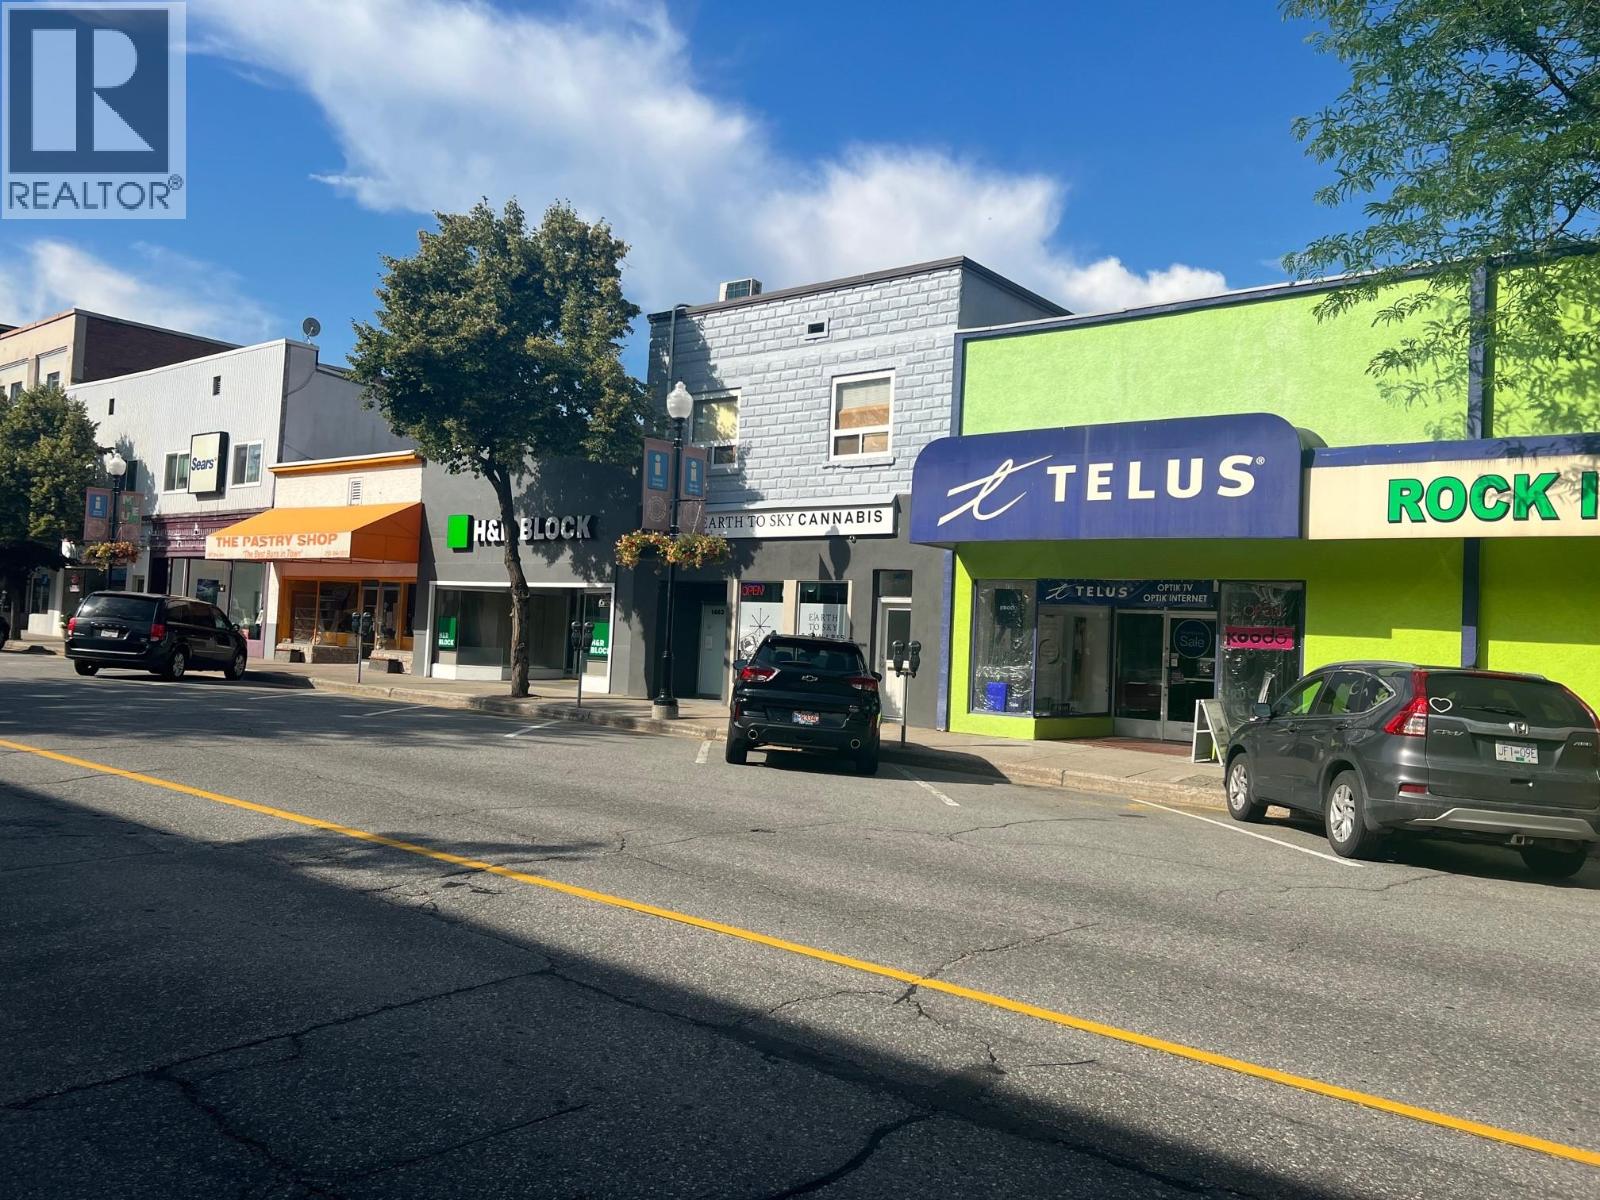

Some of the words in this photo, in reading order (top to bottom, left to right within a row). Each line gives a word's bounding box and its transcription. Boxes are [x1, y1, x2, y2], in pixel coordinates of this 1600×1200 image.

[191, 457, 215, 471] Sears
[1387, 472, 1561, 524] ROCK
[748, 513, 766, 528] TO
[770, 514, 795, 527] SKY
[799, 510, 883, 526] CANNABIS
[520, 514, 592, 541] BLOCK
[216, 537, 239, 548] THE
[242, 534, 292, 548] PASTRY
[297, 533, 338, 547] SHOP
[1076, 586, 1128, 598] TELUS
[1157, 584, 1180, 592] OPTIK
[1143, 594, 1168, 602] OPTIK
[1169, 594, 1208, 603] INTERNET
[808, 612, 838, 621] EARTH
[808, 623, 820, 631] TO
[821, 623, 837, 632] SKY
[1180, 635, 1205, 648] Sale
